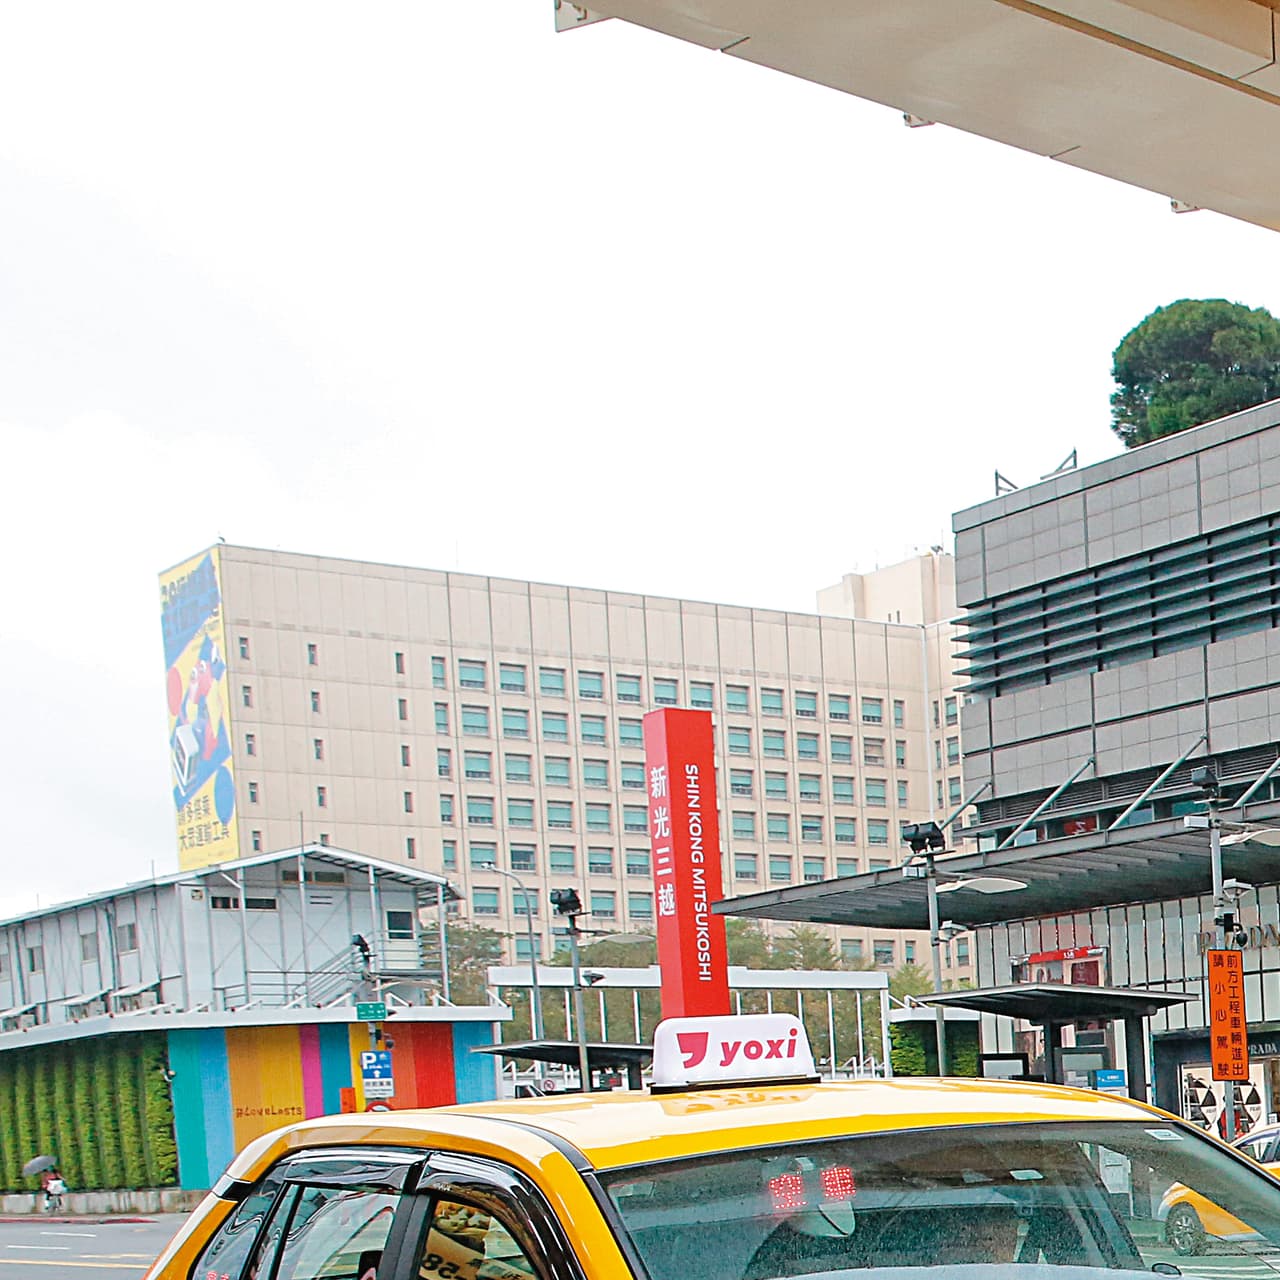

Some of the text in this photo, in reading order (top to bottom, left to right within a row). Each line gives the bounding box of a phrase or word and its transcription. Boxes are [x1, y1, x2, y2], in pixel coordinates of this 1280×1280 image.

[650, 765, 676, 917] 新光三越
[685, 764, 712, 981] SHIN KONG MITSUKOSHI
[362, 1053, 376, 1069] P
[719, 1028, 798, 1067] yoxi
[1212, 953, 1230, 1077] 請小心駕駛
[1226, 954, 1245, 1077] 前方工程車輛進出
